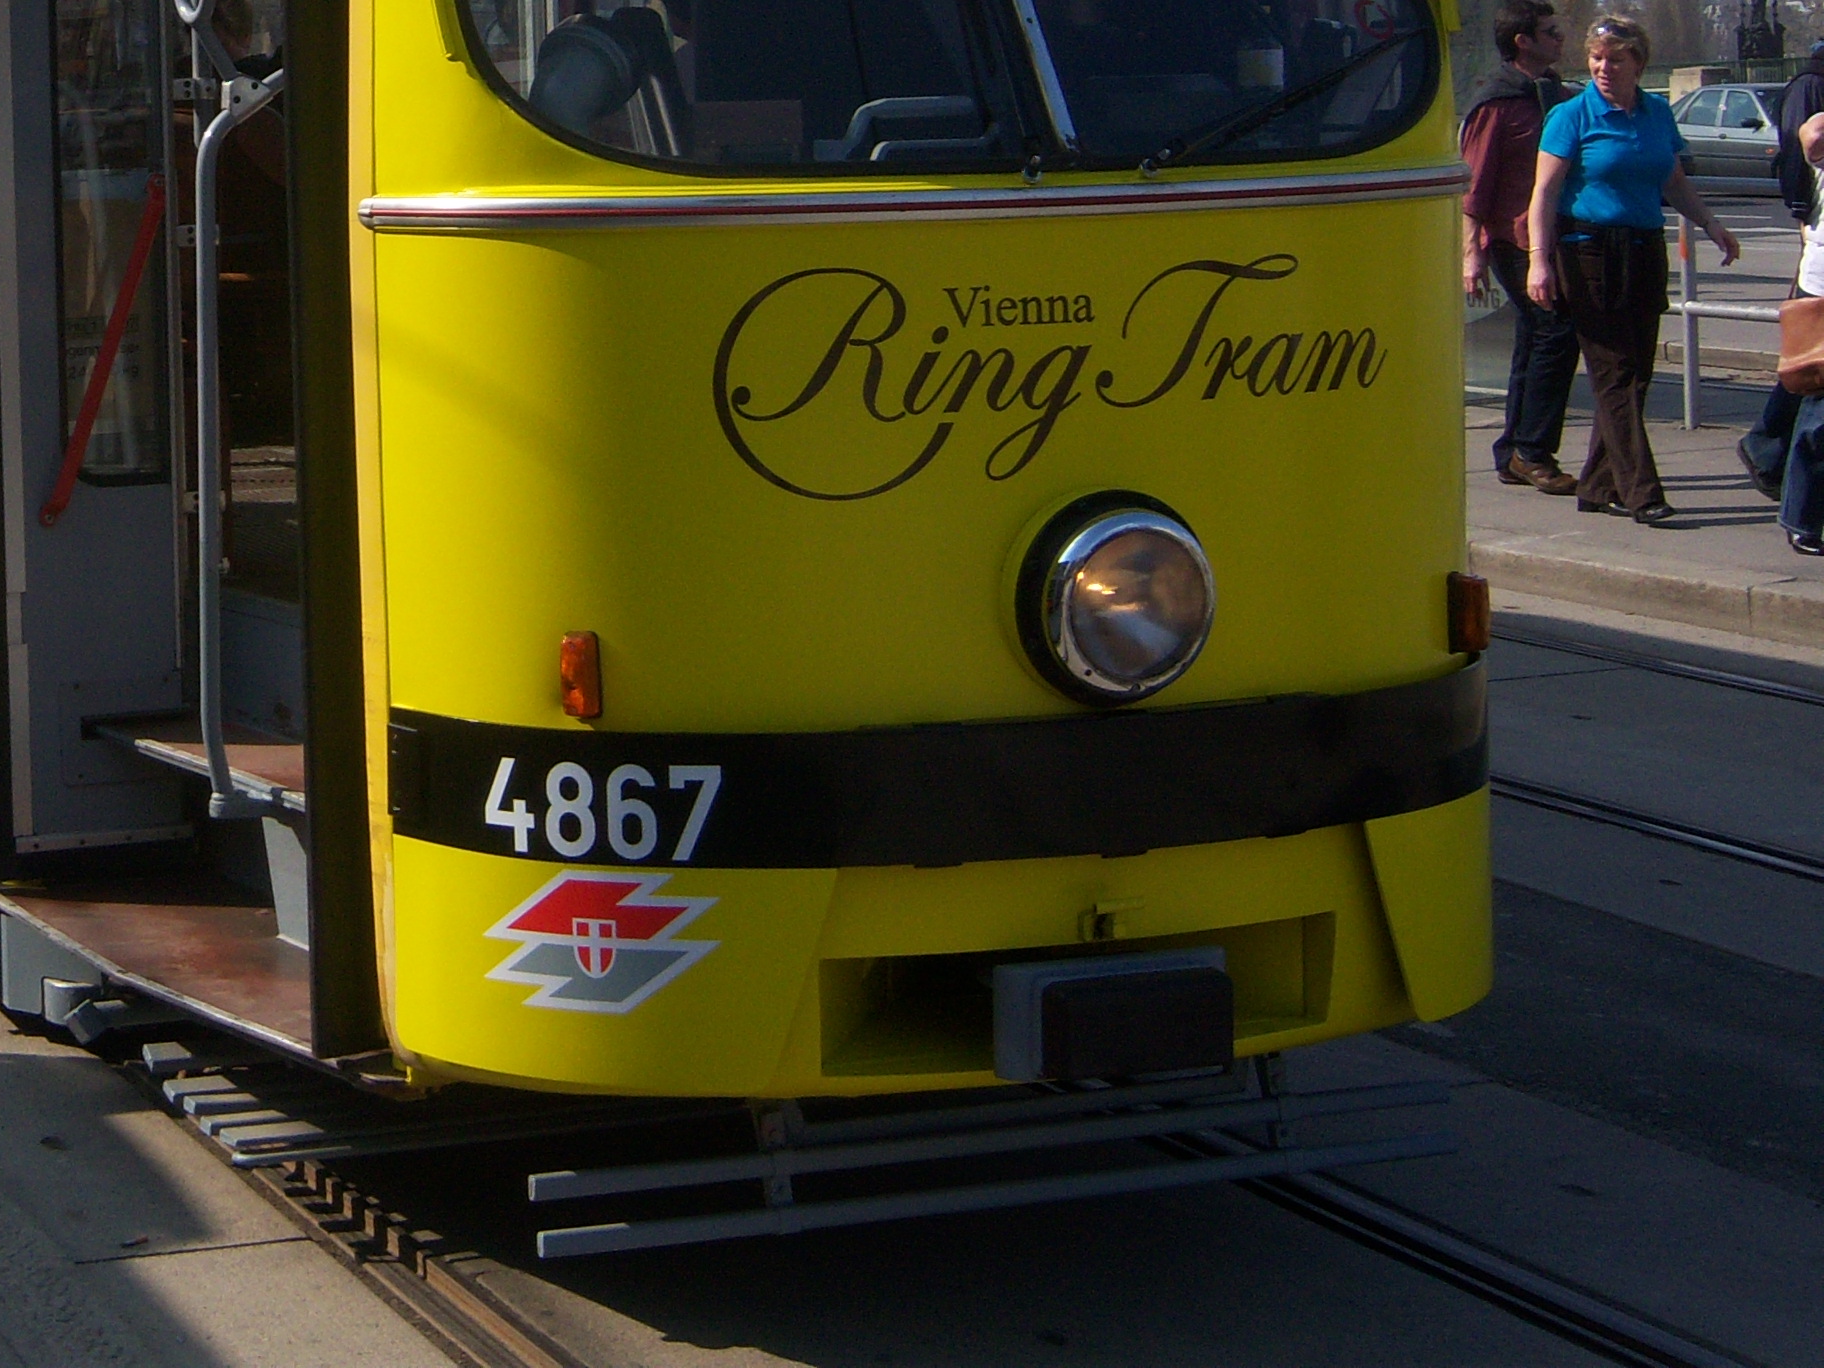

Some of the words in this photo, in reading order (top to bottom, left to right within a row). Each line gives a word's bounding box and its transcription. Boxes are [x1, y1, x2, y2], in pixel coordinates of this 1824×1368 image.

[943, 285, 1095, 330] Vienna
[712, 267, 1093, 501] Ring
[1095, 253, 1388, 409] Tram
[484, 757, 722, 862] 4867
